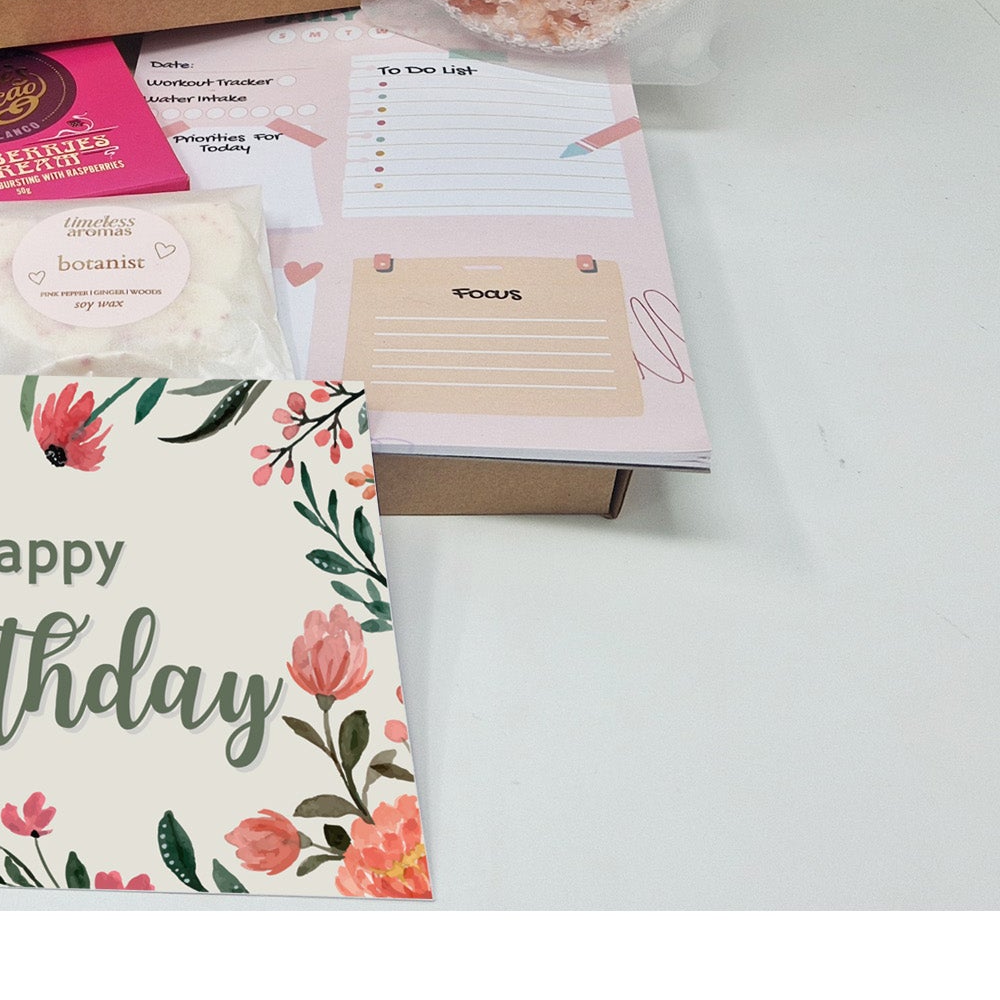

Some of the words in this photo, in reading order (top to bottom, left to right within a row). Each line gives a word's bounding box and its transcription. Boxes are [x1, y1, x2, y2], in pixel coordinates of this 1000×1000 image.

[150, 61, 195, 69] Date:
[377, 65, 401, 76] To
[404, 66, 437, 75] Do
[442, 65, 478, 76] List
[147, 78, 215, 88] Workout
[216, 77, 274, 87] Tracker
[197, 94, 248, 103] Intake
[173, 132, 246, 144] Priorities
[254, 133, 284, 142] For
[200, 144, 251, 155] Today
[42, 169, 66, 182] WITH
[66, 159, 126, 178] RASPBERRIES
[16, 187, 33, 196] 50g
[63, 215, 136, 229] timeless
[67, 226, 133, 238] aromas
[57, 254, 146, 272] botanist
[74, 300, 94, 312] soy
[97, 300, 124, 309] wax
